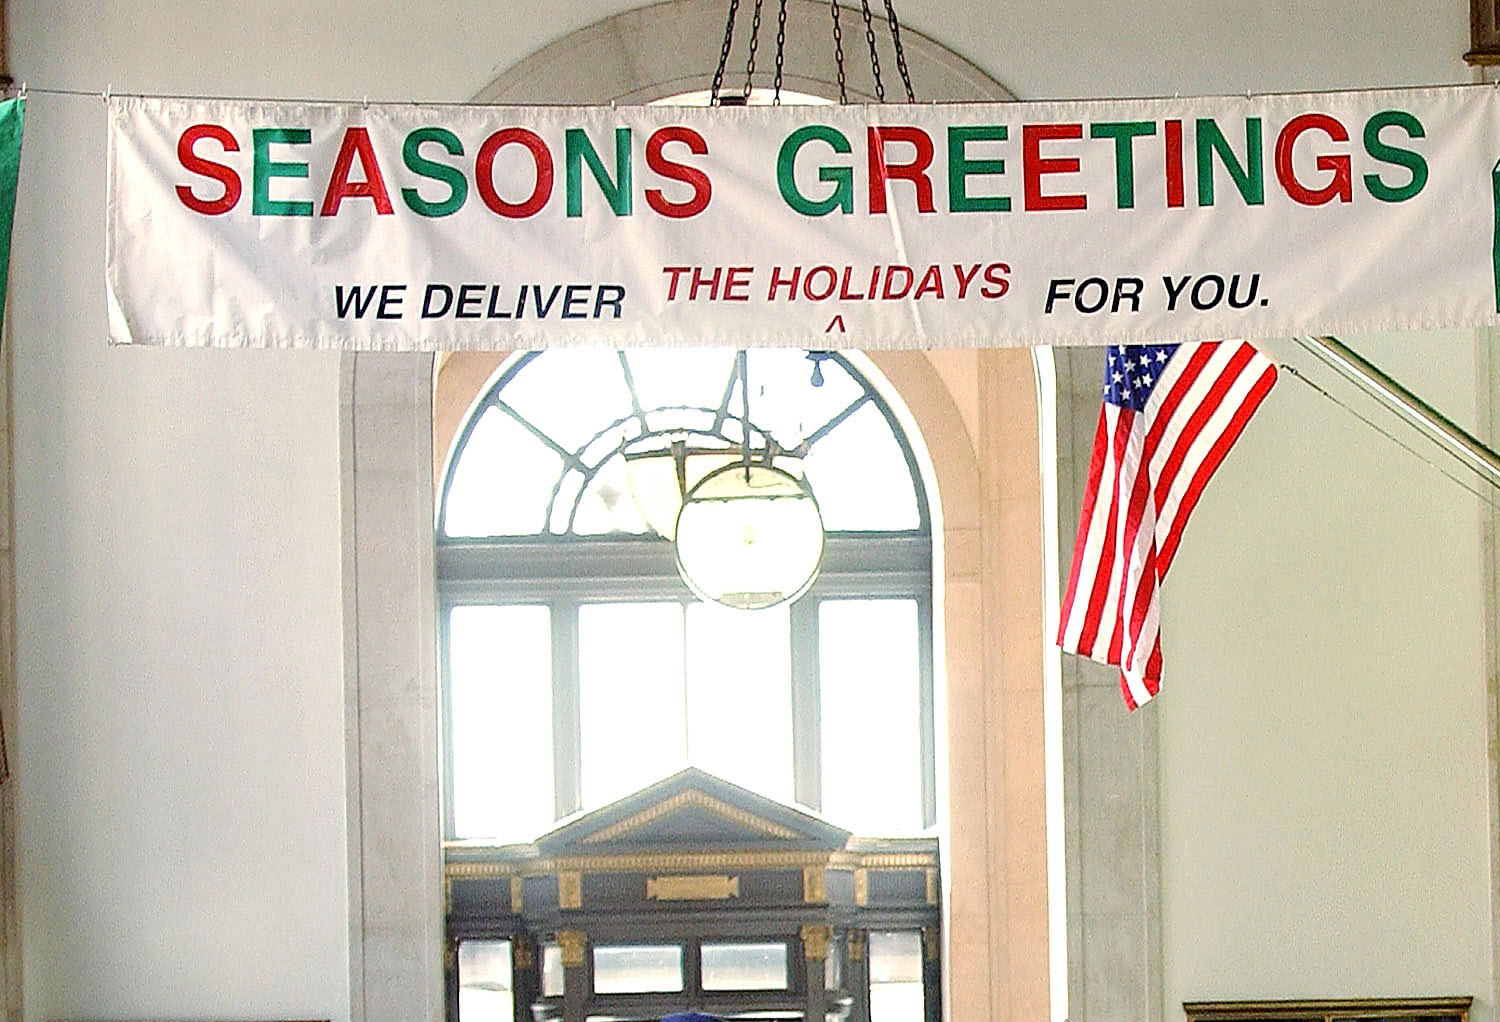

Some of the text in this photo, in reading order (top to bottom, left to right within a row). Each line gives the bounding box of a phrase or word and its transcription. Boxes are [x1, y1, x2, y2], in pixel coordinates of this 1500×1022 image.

[174, 108, 1430, 219] SEASONS GREETINGS
[661, 262, 1012, 302] THE HOLIDAYS
[1044, 273, 1270, 314] FOR YOU.
[334, 284, 626, 321] WE DELIVER
